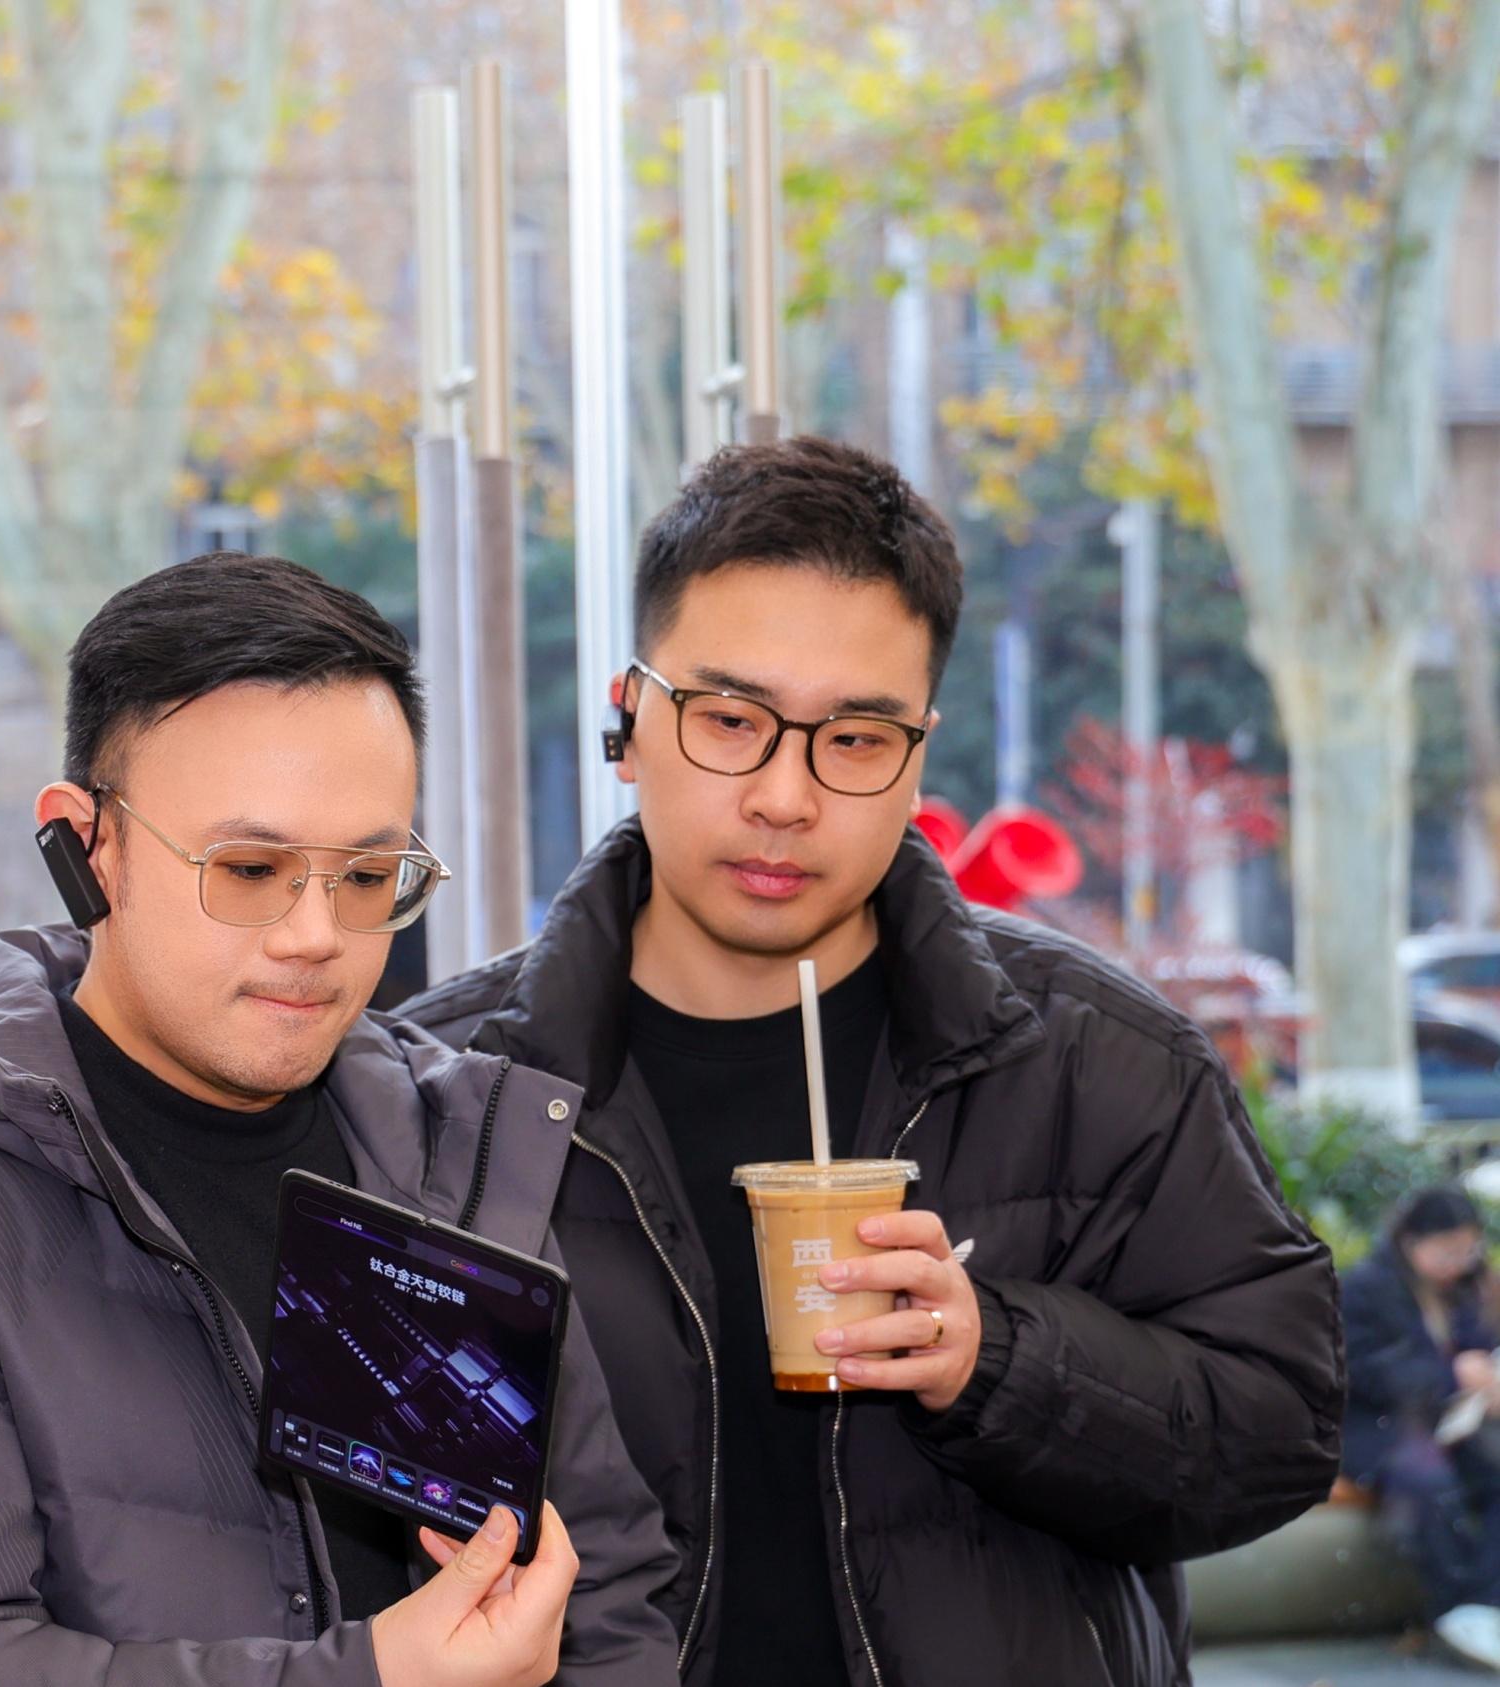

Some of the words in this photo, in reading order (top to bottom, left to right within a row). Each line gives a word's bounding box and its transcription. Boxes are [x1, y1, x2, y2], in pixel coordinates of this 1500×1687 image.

[369, 1256, 467, 1307] 钛合金天穹铰链
